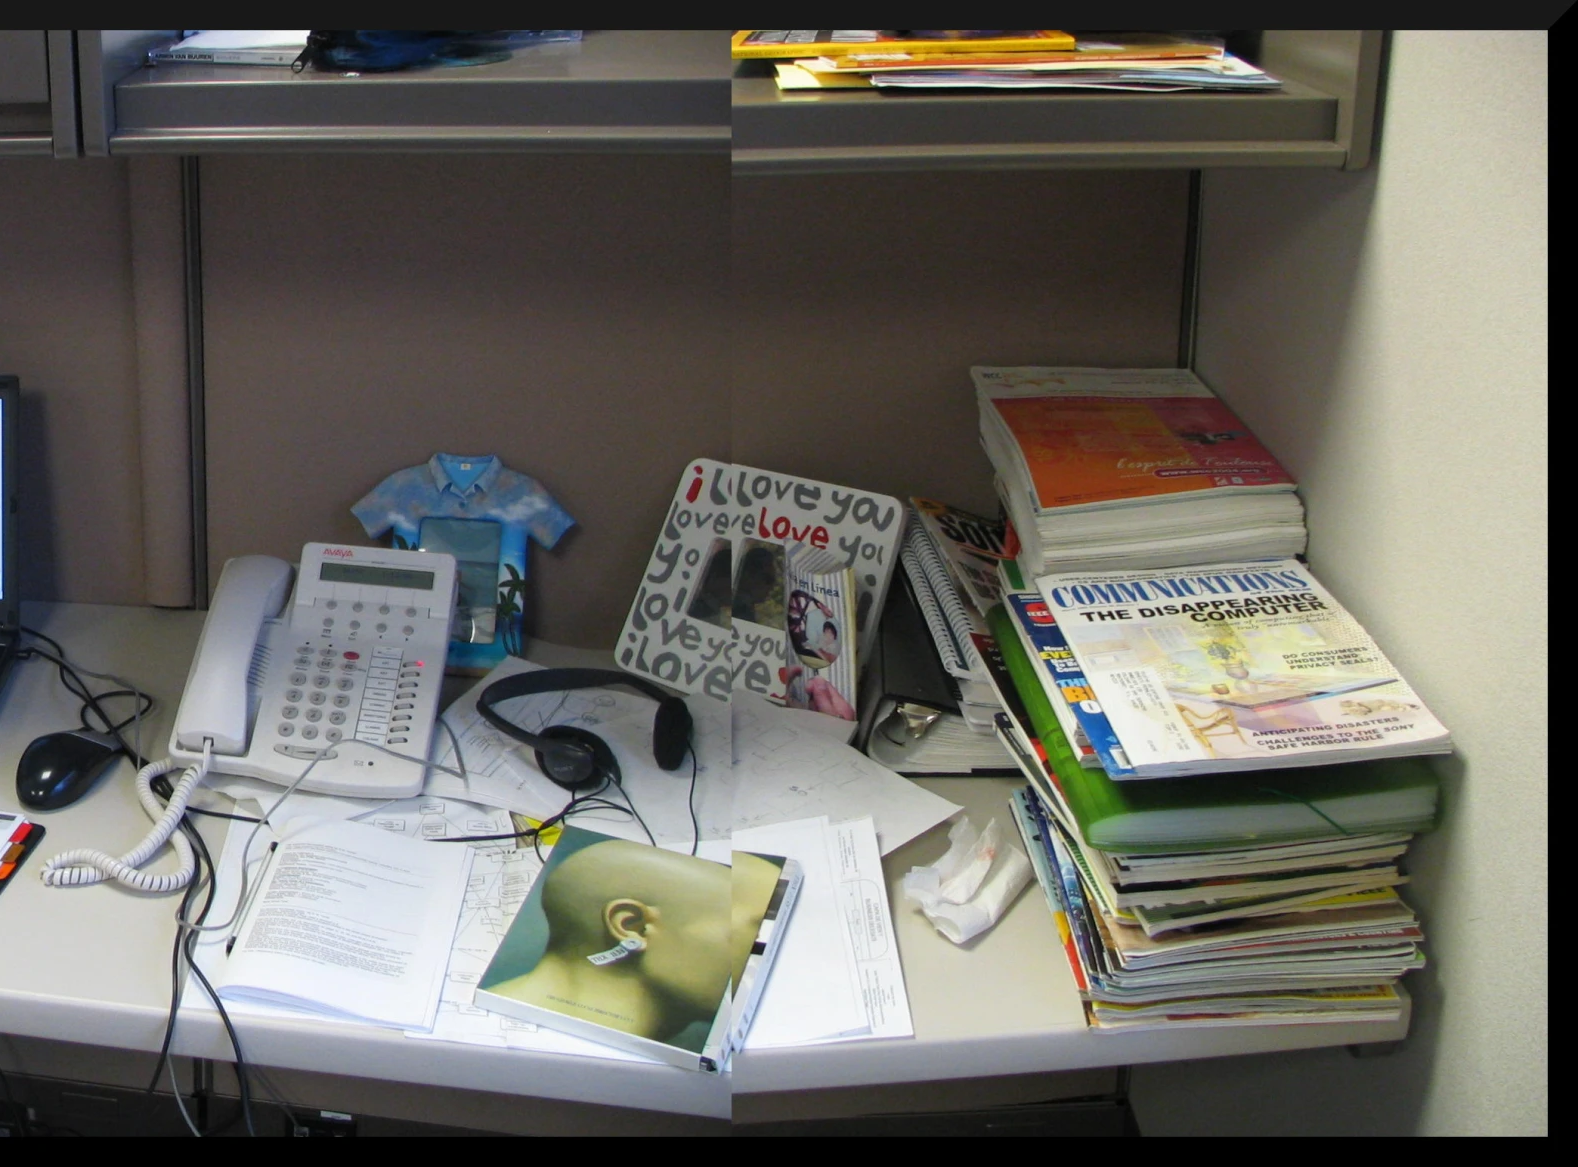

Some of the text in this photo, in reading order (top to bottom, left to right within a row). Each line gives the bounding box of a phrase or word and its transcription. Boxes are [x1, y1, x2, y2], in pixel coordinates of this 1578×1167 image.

[823, 489, 895, 532] you
[323, 549, 354, 559] AVAYA
[1051, 569, 1309, 609] COMMUNICATIONS
[1079, 592, 1319, 622] THE DISAPPEARING
[1189, 600, 1330, 623] COMPUTER
[1282, 646, 1368, 660] DO CONSUMERS
[1286, 653, 1359, 665] UNDERSTAND
[1289, 656, 1379, 670] PRIVACY SEALS?
[1252, 716, 1400, 737] ANTICIPATING DISASTERS
[1256, 733, 1335, 746] CHALLENGES
[1355, 728, 1380, 737] THE
[1384, 723, 1415, 734] SONY
[1267, 733, 1385, 751] SAFE HARBOR RULE
